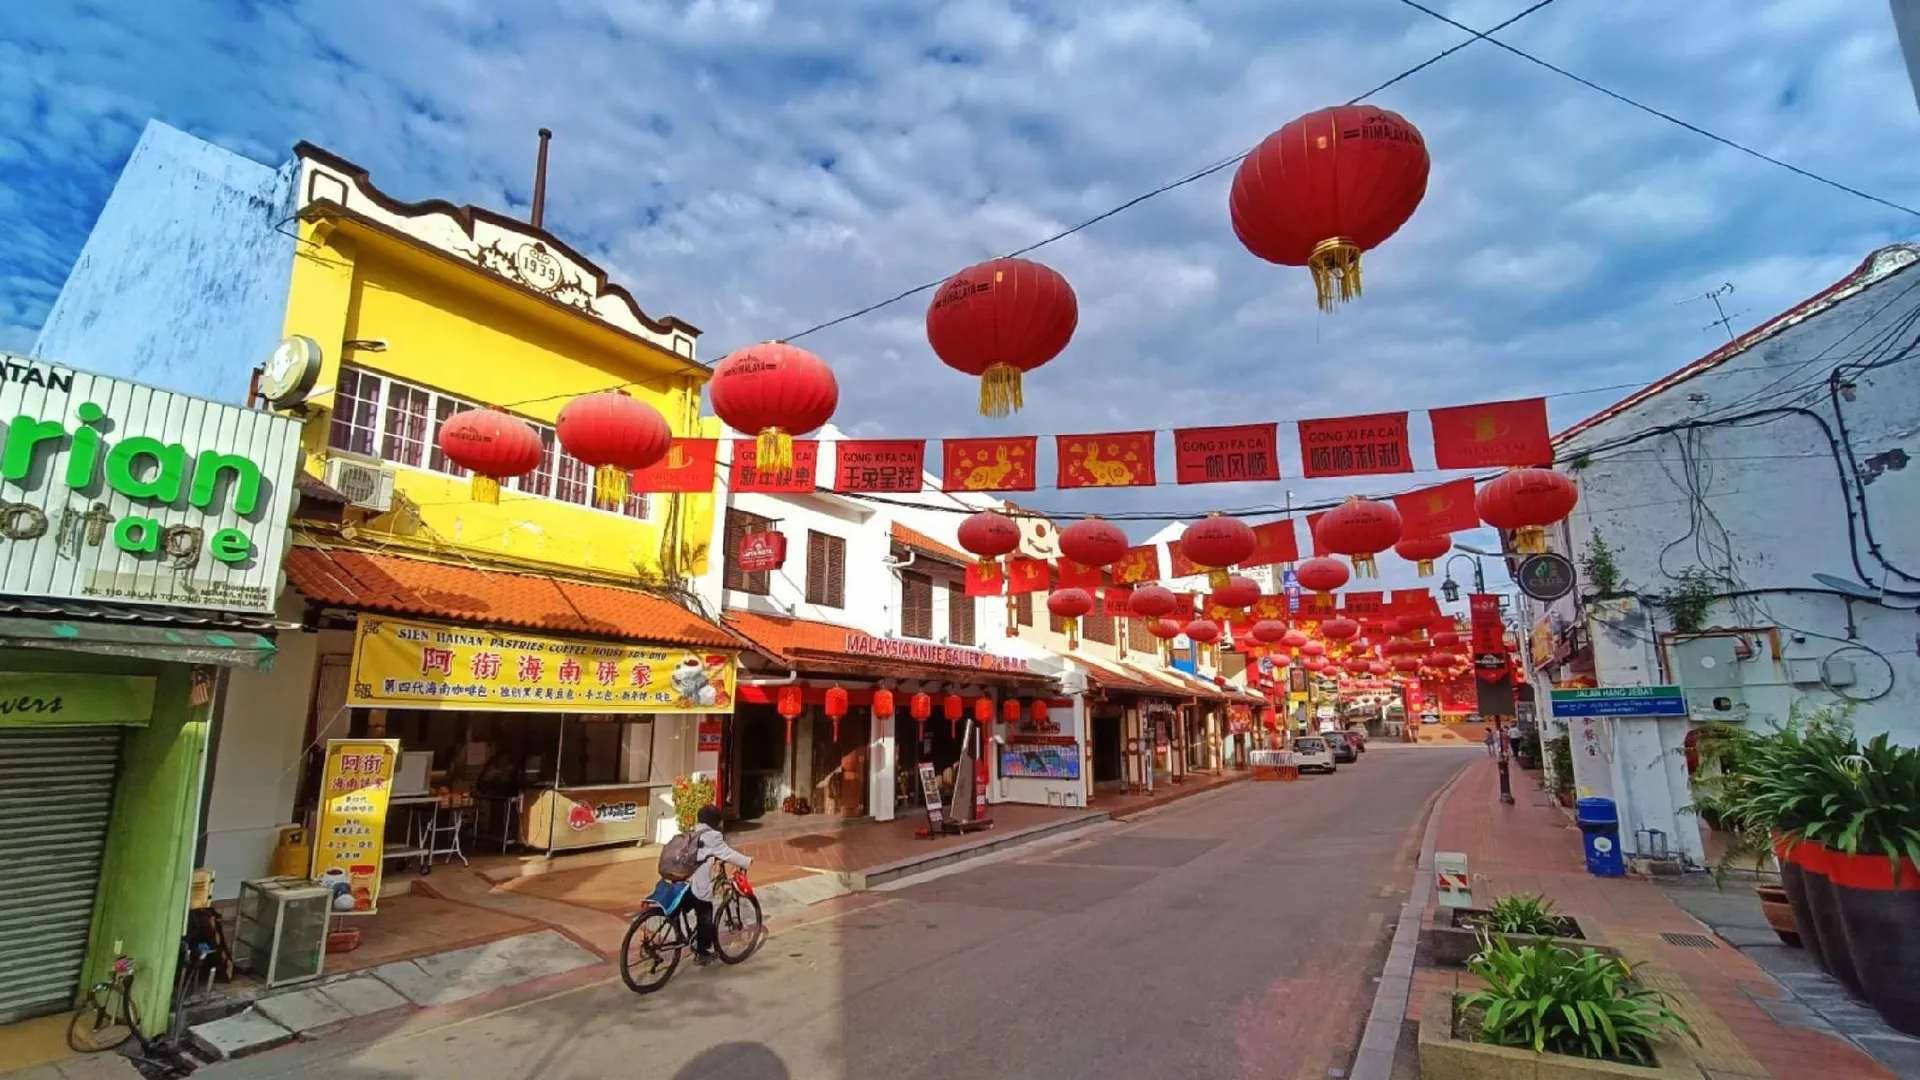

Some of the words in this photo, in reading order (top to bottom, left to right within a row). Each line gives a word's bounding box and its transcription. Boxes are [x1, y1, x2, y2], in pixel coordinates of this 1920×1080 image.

[524, 257, 555, 281] 1939
[1183, 440, 1215, 452] GONG
[1218, 439, 1228, 450] XI
[1231, 439, 1245, 450] FA
[1247, 438, 1266, 449] CAI
[1309, 432, 1343, 443] GONG
[1346, 430, 1357, 441] XI
[1360, 429, 1374, 440] FA
[1378, 427, 1398, 438] CAI
[843, 453, 870, 463] GONG
[875, 453, 884, 462] XI
[886, 453, 897, 462] FA
[900, 453, 916, 463] CAI
[1185, 452, 1268, 477] 一帆风顺
[1310, 442, 1400, 470] 顺顺利利
[398, 628, 429, 641] SIEN
[436, 632, 485, 647] HAINAN
[490, 638, 544, 651] PASTRIES
[549, 643, 587, 655] COFFEE
[593, 647, 623, 657] HOUSE
[847, 635, 909, 657] MALAYSIA
[913, 646, 943, 662] KNIFE
[945, 650, 983, 668] GALLERY
[1576, 688, 1601, 698] JALAN
[1603, 687, 1627, 697] HANG
[1628, 686, 1654, 697] JEBAT
